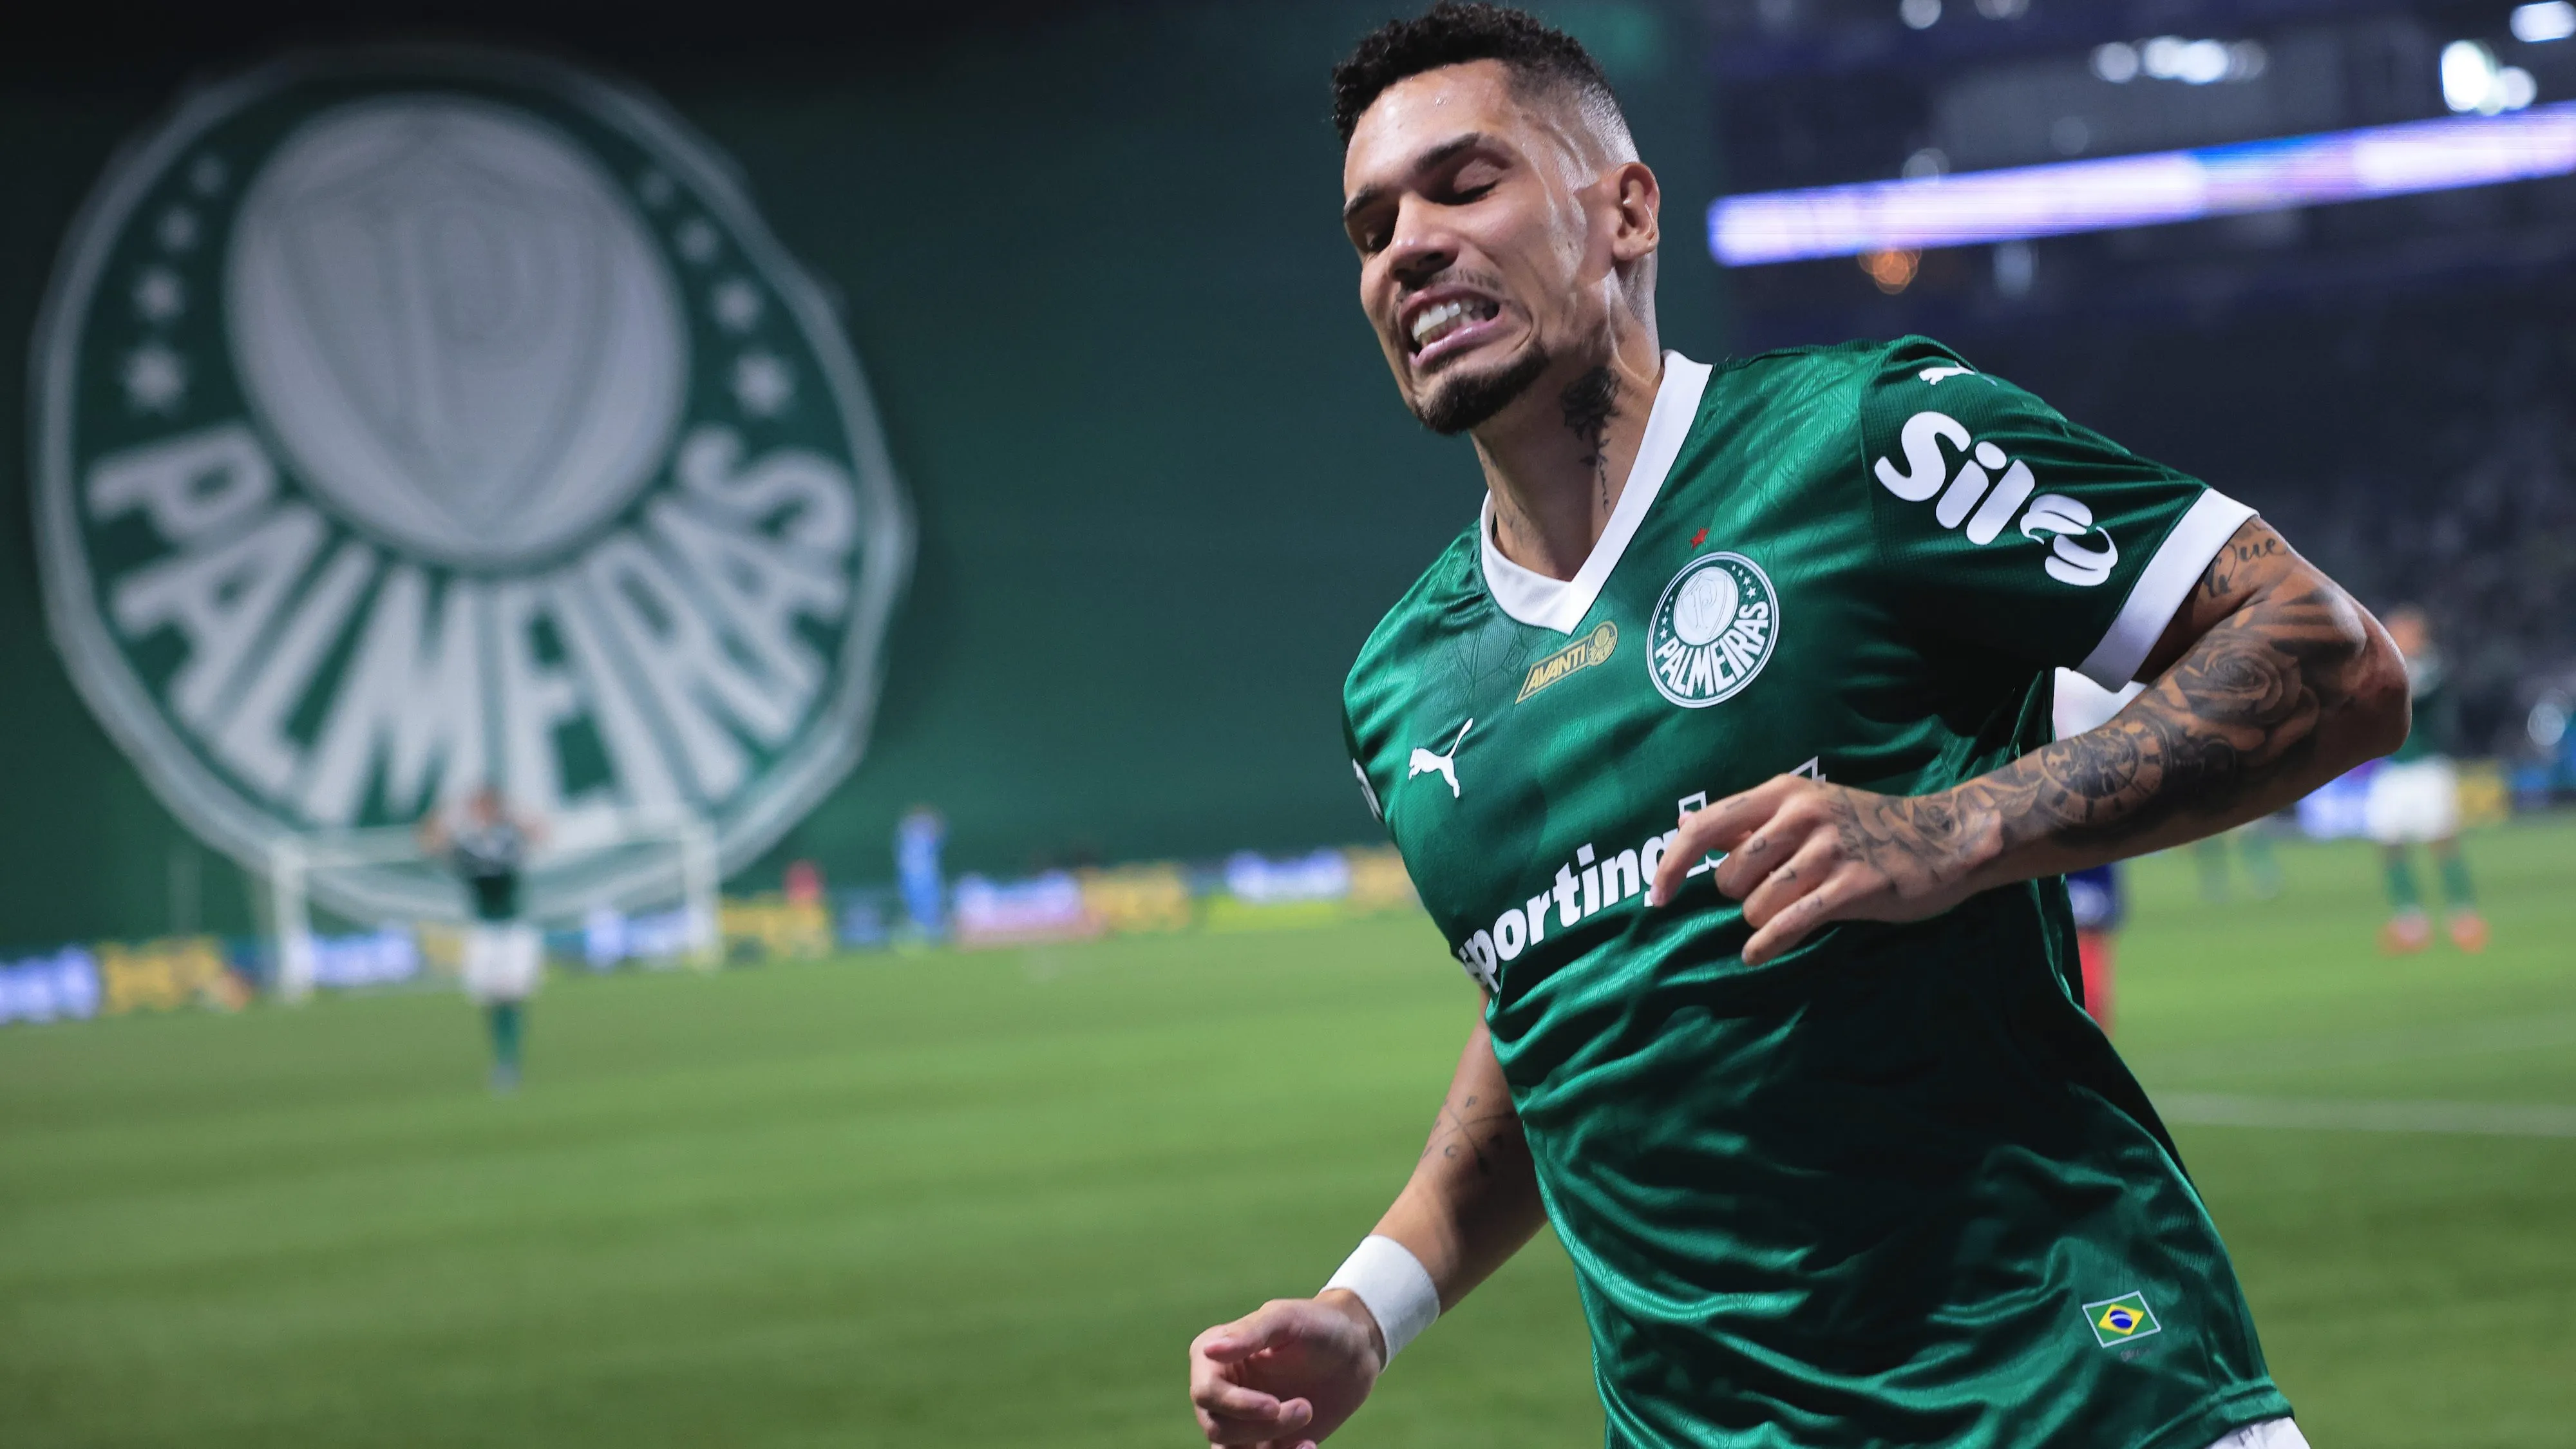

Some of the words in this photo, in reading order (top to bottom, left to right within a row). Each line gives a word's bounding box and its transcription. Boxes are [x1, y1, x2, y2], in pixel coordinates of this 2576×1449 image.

[85, 422, 858, 842] PALMEIRAS
[1524, 643, 1586, 695] AVANTI
[1655, 601, 1769, 697] PALMEIRAS
